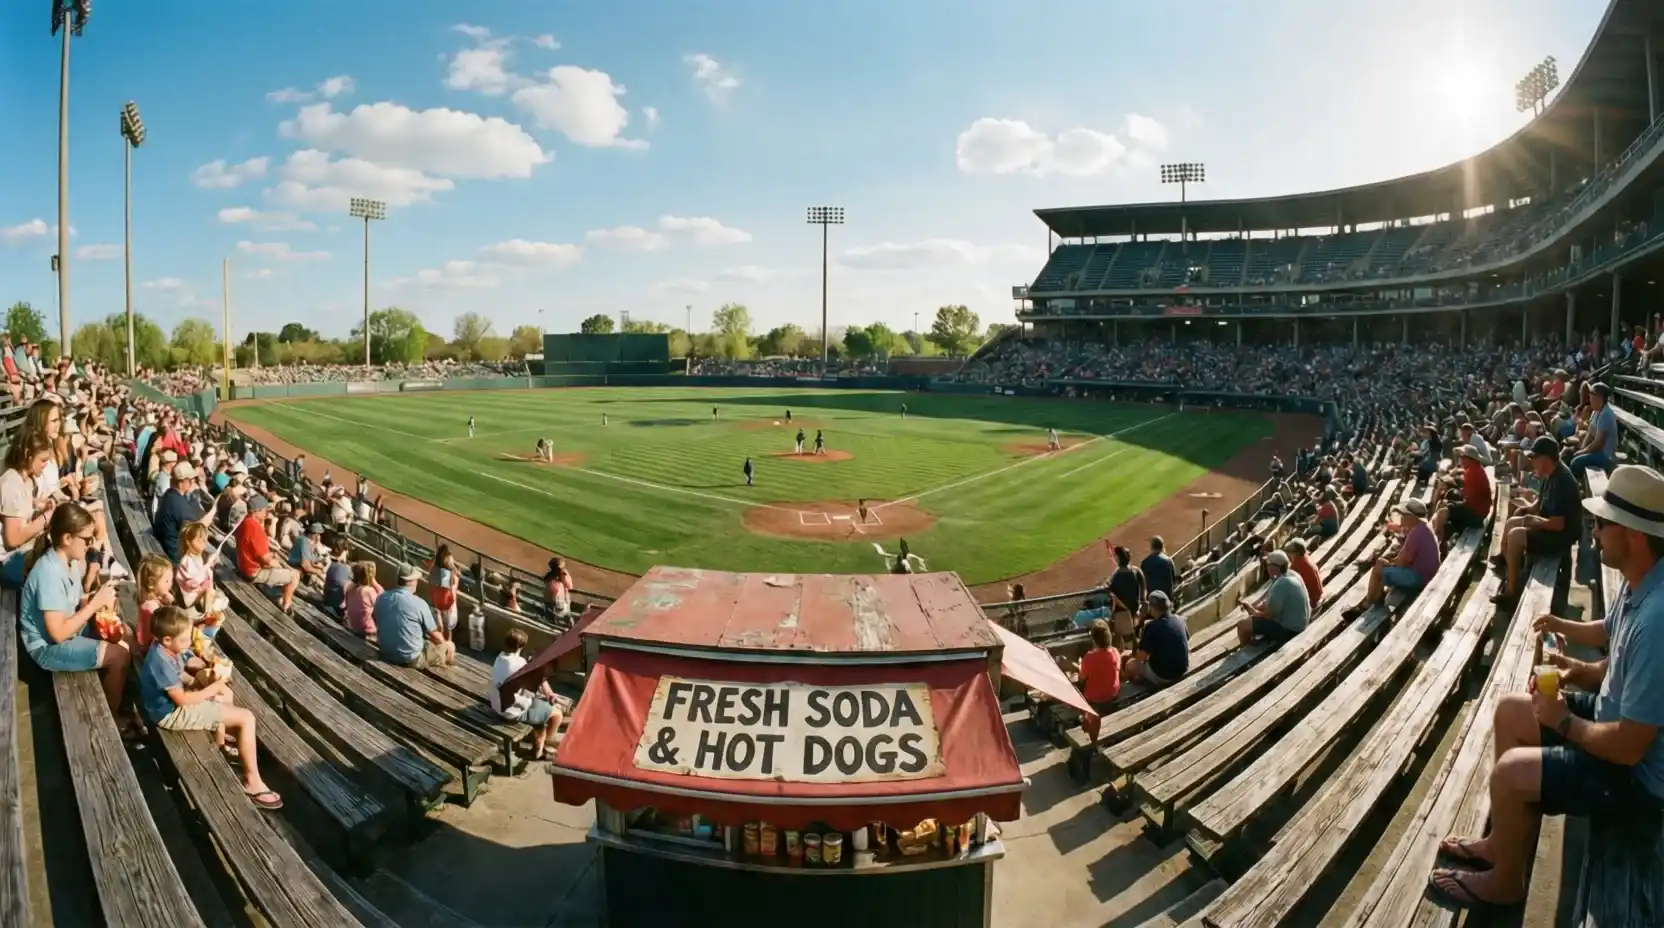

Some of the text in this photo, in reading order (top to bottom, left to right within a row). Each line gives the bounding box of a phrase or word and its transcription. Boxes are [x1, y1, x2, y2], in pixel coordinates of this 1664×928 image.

[663, 683, 924, 728] FRESH SODA
[648, 727, 928, 775] & HOT DOGS
